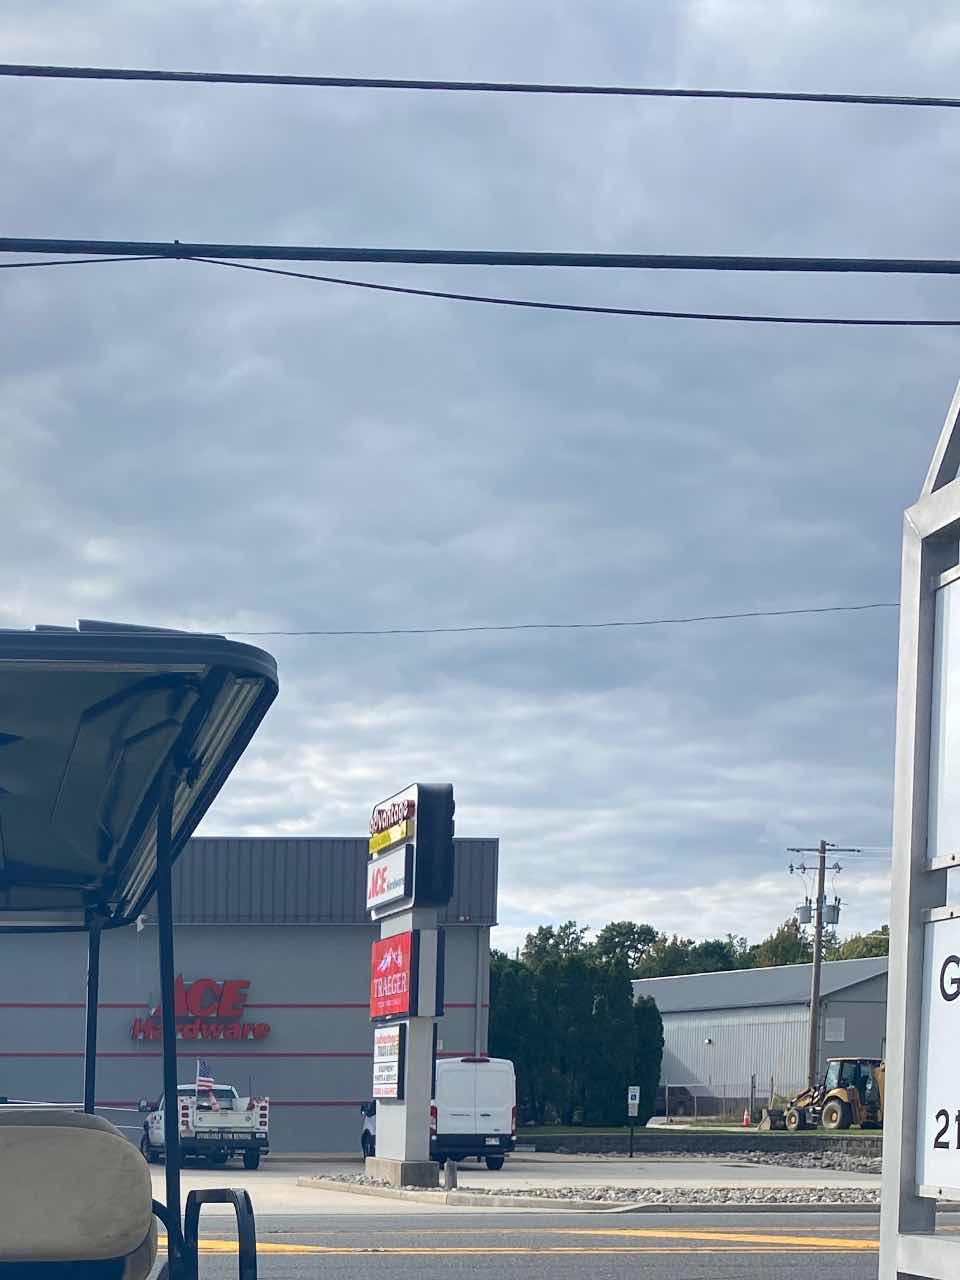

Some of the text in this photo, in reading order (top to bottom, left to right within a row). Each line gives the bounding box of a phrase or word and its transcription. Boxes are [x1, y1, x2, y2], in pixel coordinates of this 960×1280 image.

[368, 800, 408, 833] advantage
[368, 865, 388, 900] ACE
[150, 974, 250, 1017] ACE
[373, 971, 407, 998] TRAEGER
[131, 1018, 271, 1041] Hadware
